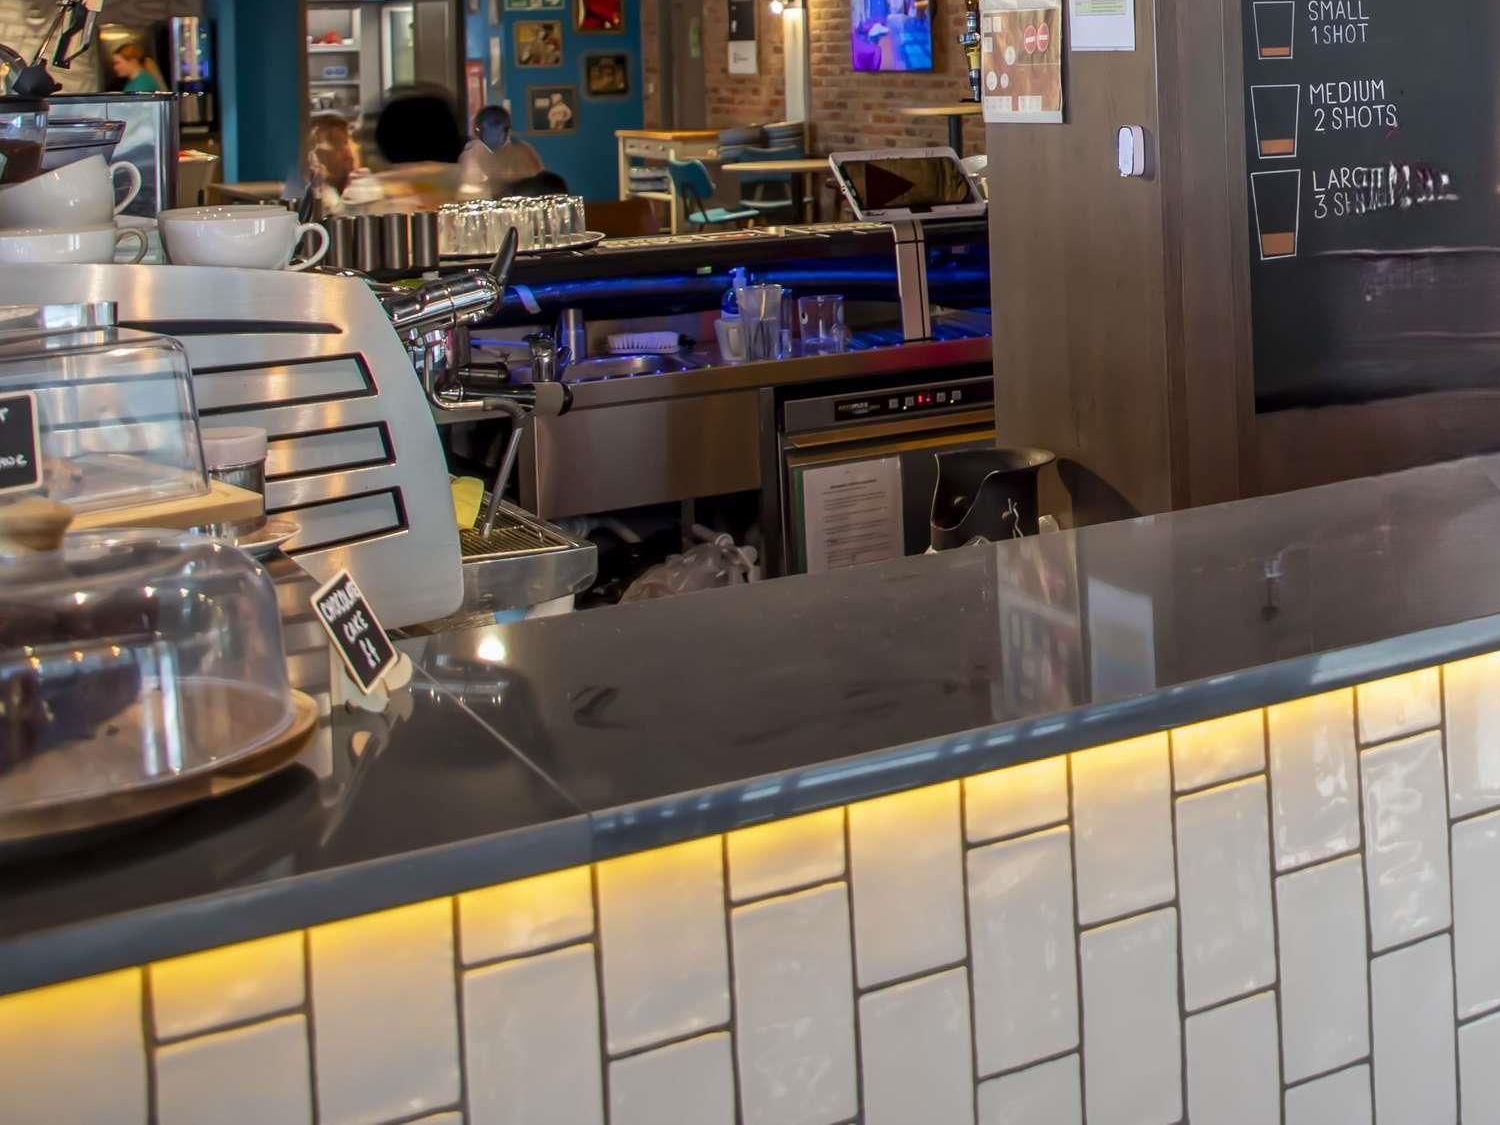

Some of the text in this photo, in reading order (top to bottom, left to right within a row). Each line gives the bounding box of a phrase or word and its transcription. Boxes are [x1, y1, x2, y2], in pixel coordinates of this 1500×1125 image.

[1308, 0, 1369, 21] SMALL
[1309, 79, 1386, 105] MEDIUM
[1314, 105, 1398, 131] 2 SHOTS
[1314, 195, 1327, 219] 3
